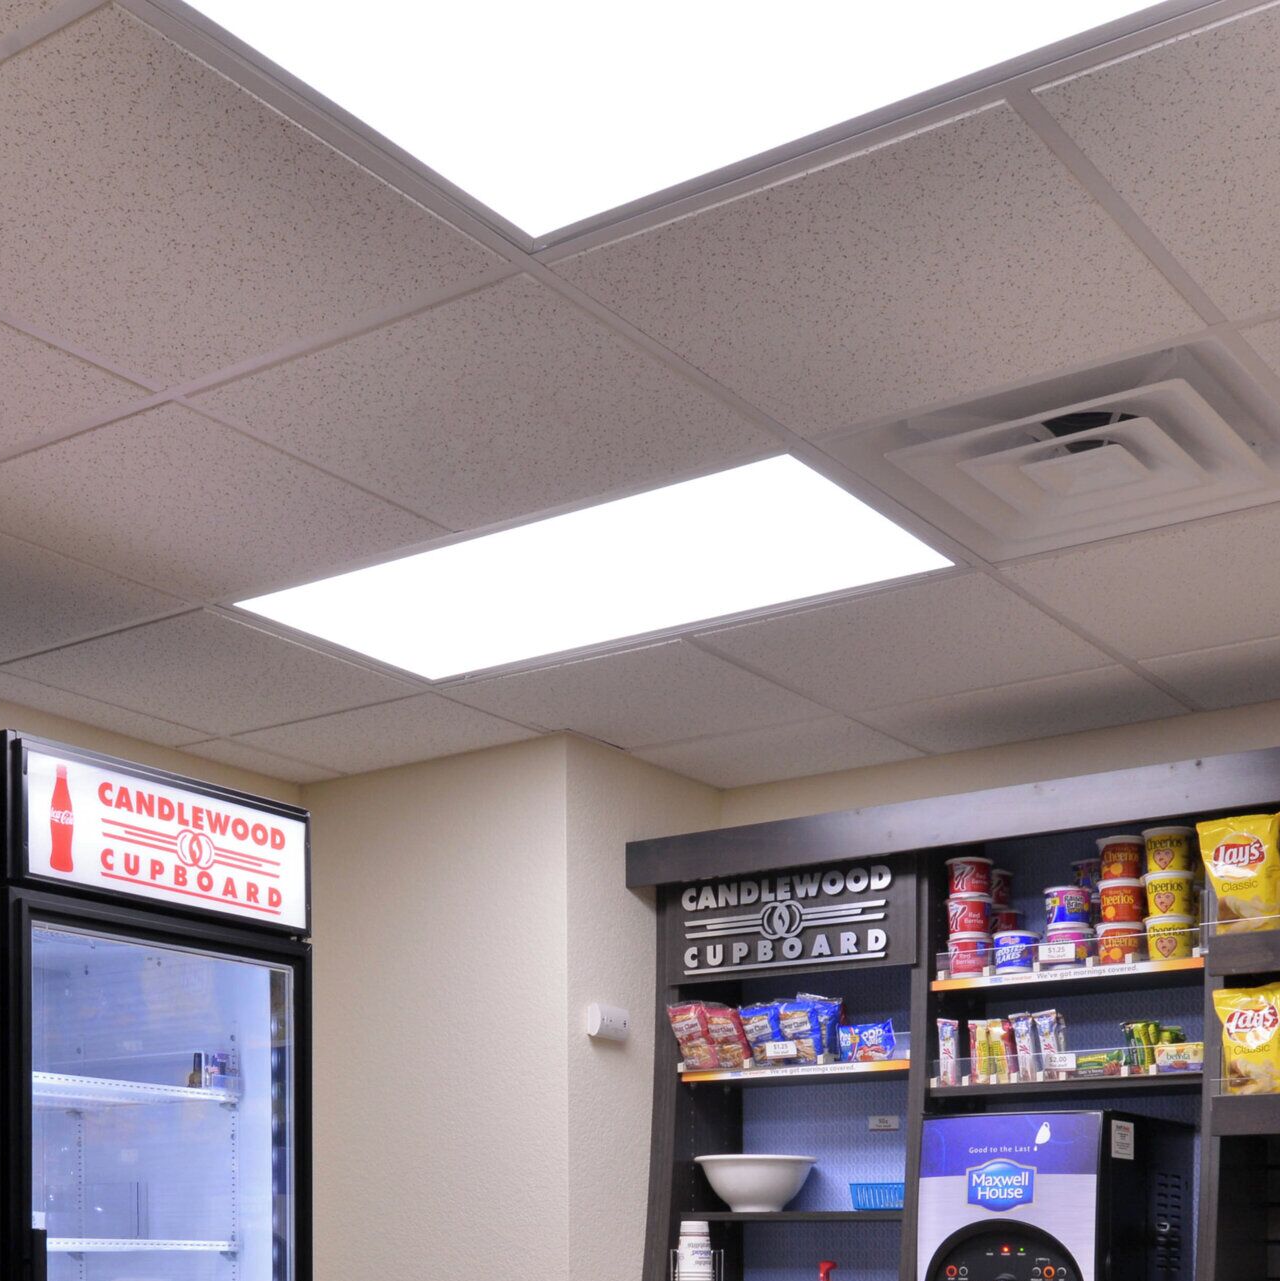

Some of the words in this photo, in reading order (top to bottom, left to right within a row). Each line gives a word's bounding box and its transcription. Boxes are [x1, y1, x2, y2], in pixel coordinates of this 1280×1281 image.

[98, 781, 286, 851] CANDLEWOOD
[101, 848, 282, 908] CUPBOARD
[1221, 878, 1258, 892] Classic
[682, 865, 892, 911] CANDLEWOOD
[684, 928, 887, 968] CUPBOARD
[1060, 970, 1072, 979] got
[1073, 968, 1106, 978] mornings
[1233, 1043, 1271, 1056] Classic
[801, 1065, 829, 1074] mornings
[969, 1146, 987, 1154] Good
[1015, 1145, 1030, 1153] Last
[972, 1172, 1028, 1187] Maxwell
[977, 1186, 1023, 1200] House
